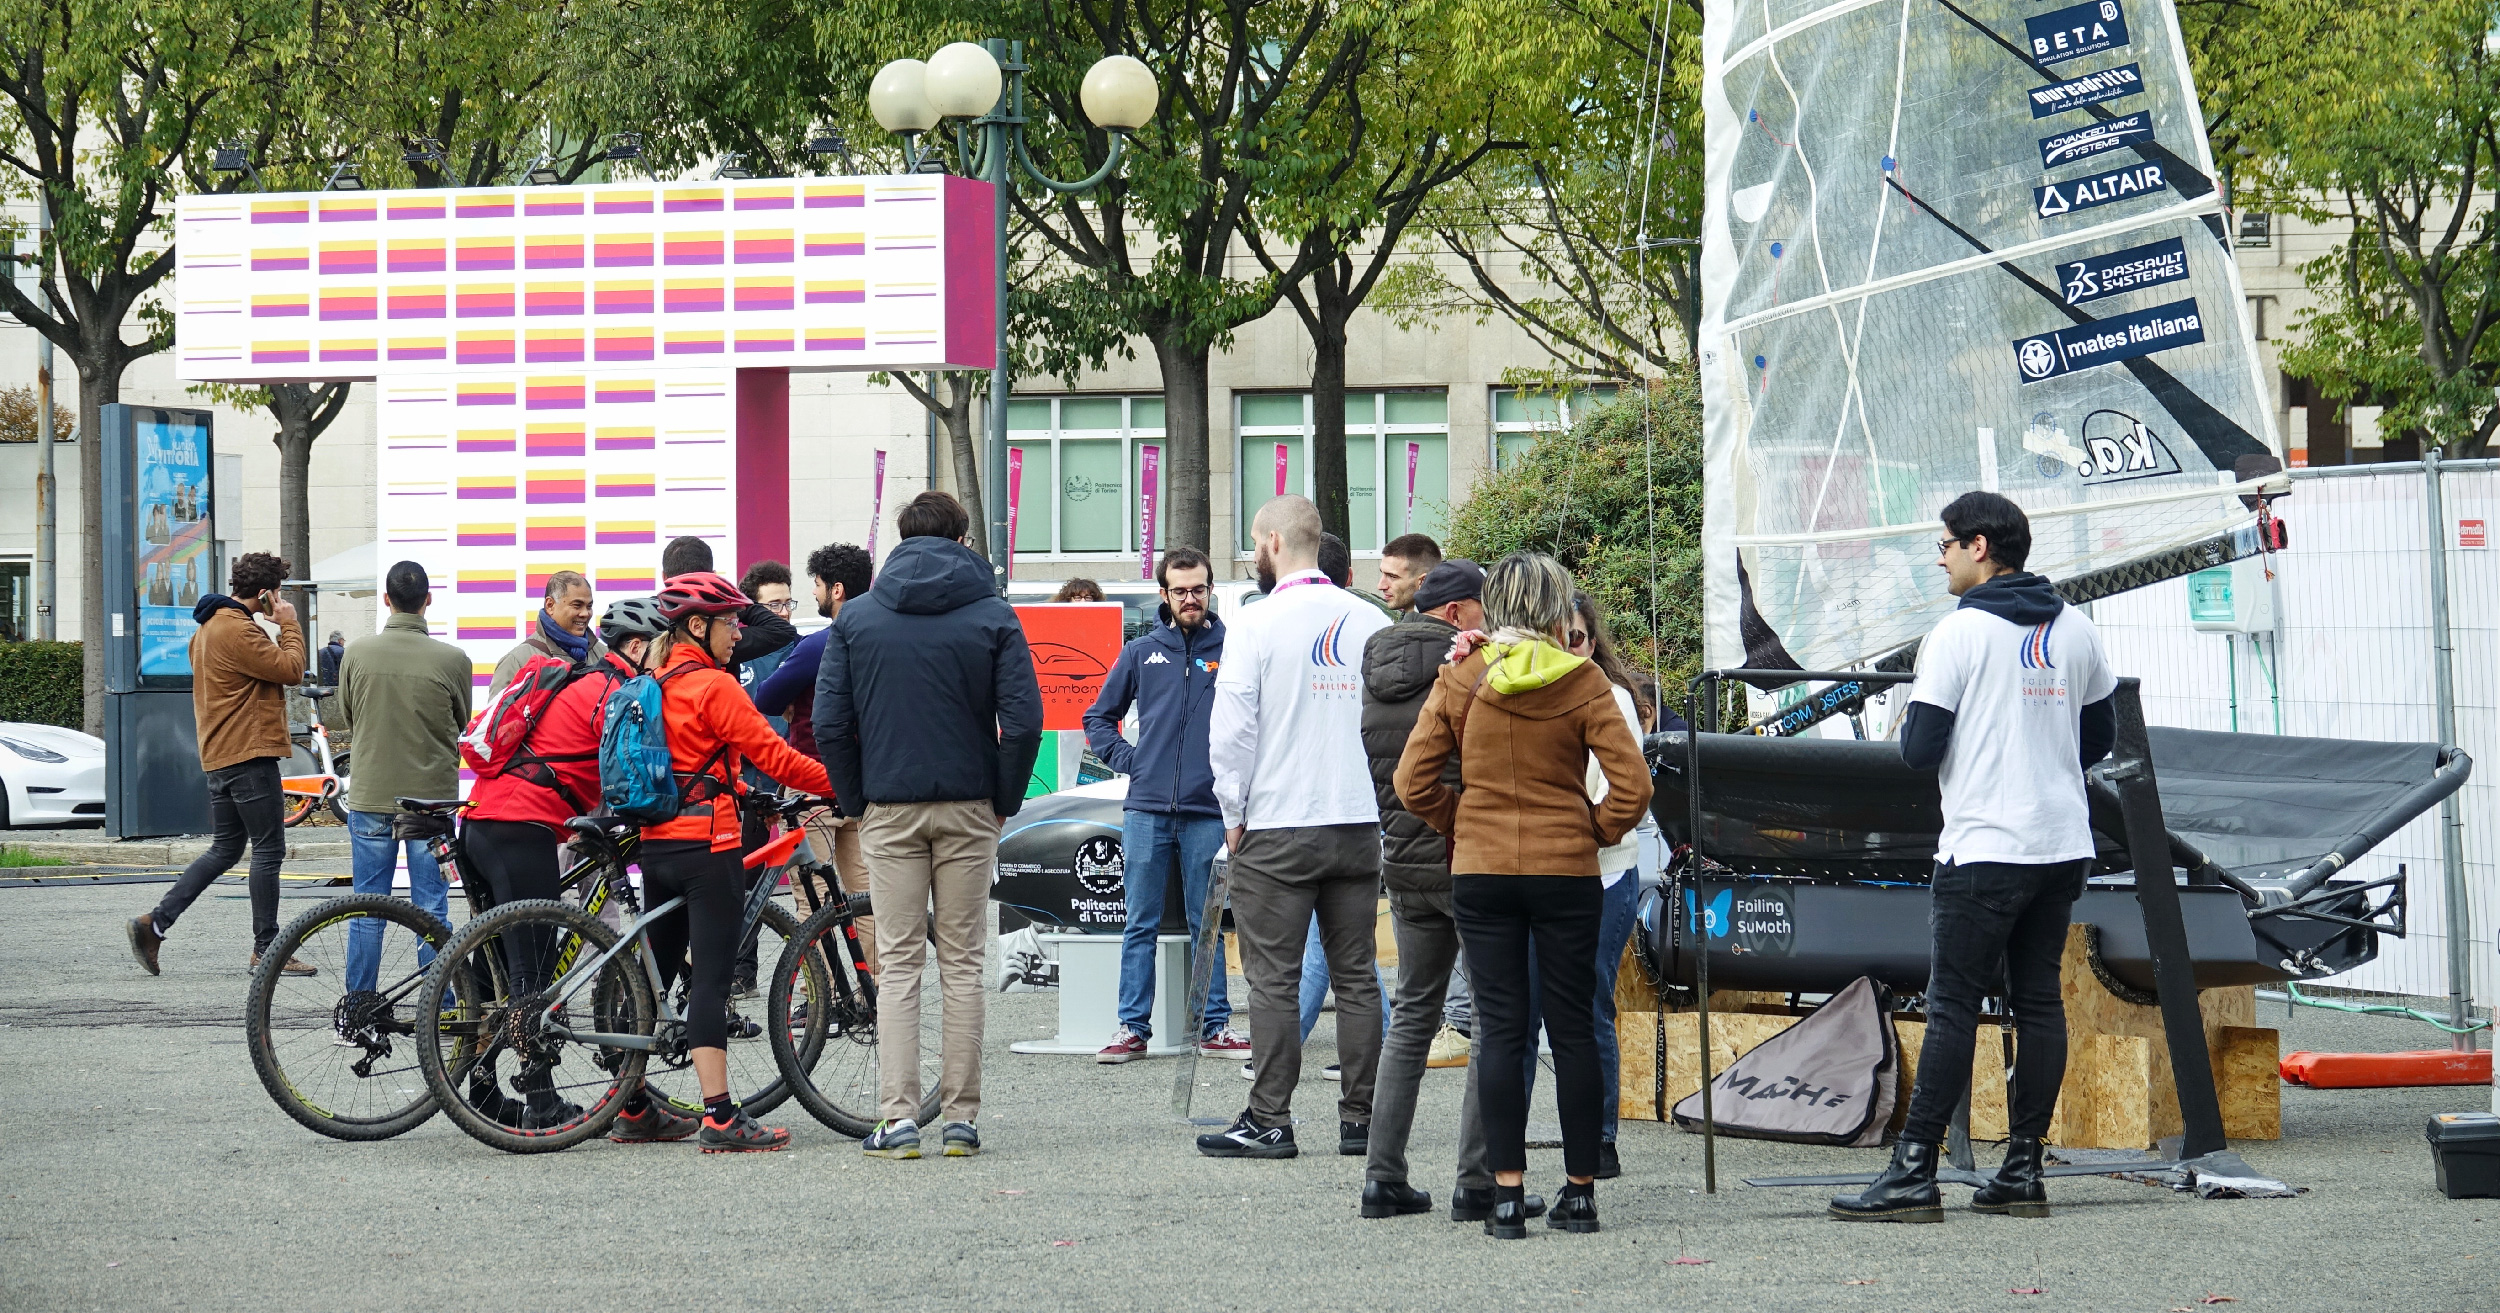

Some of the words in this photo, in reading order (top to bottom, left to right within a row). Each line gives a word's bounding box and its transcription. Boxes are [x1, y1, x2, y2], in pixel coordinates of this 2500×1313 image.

[2034, 22, 2108, 55] BETA
[2046, 125, 2106, 150] ADVANCED
[2108, 117, 2139, 132] WING
[2065, 136, 2120, 159] SYSTEMS
[2075, 166, 2163, 205] ALTAIR
[2101, 251, 2183, 280] DASSAULT
[2066, 330, 2127, 358] mates
[2129, 314, 2200, 344] italiana
[1312, 683, 1356, 691] SAILING
[2022, 677, 2067, 686] POLITO
[2022, 687, 2065, 696] SAILING
[2023, 698, 2065, 707] TEAM
[743, 869, 781, 925] CUBE
[1079, 911, 1091, 923] di
[1737, 899, 1784, 916] Foiling
[1737, 920, 1791, 934] SuMoth
